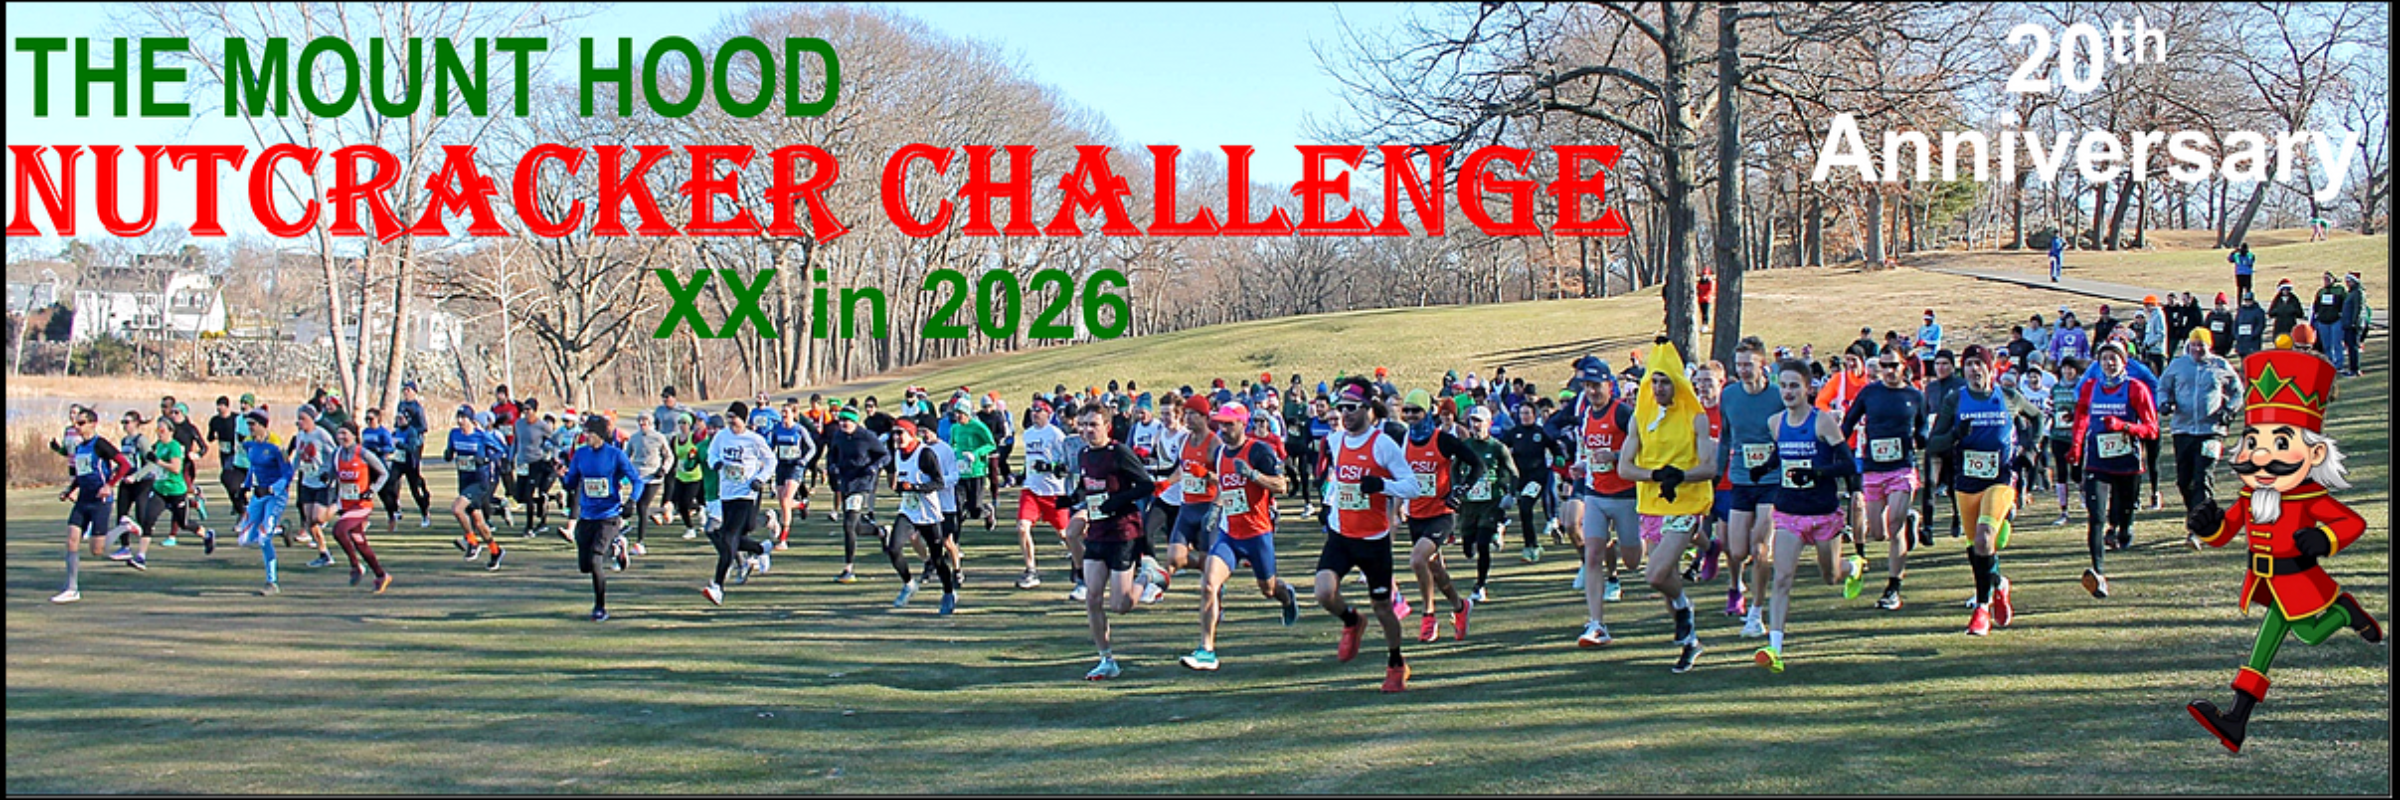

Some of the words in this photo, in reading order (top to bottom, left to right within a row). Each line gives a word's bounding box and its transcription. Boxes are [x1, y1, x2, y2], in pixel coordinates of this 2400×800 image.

[1588, 433, 1612, 447] CSU
[1411, 460, 1438, 473] CSU
[1222, 473, 1247, 486] CSU
